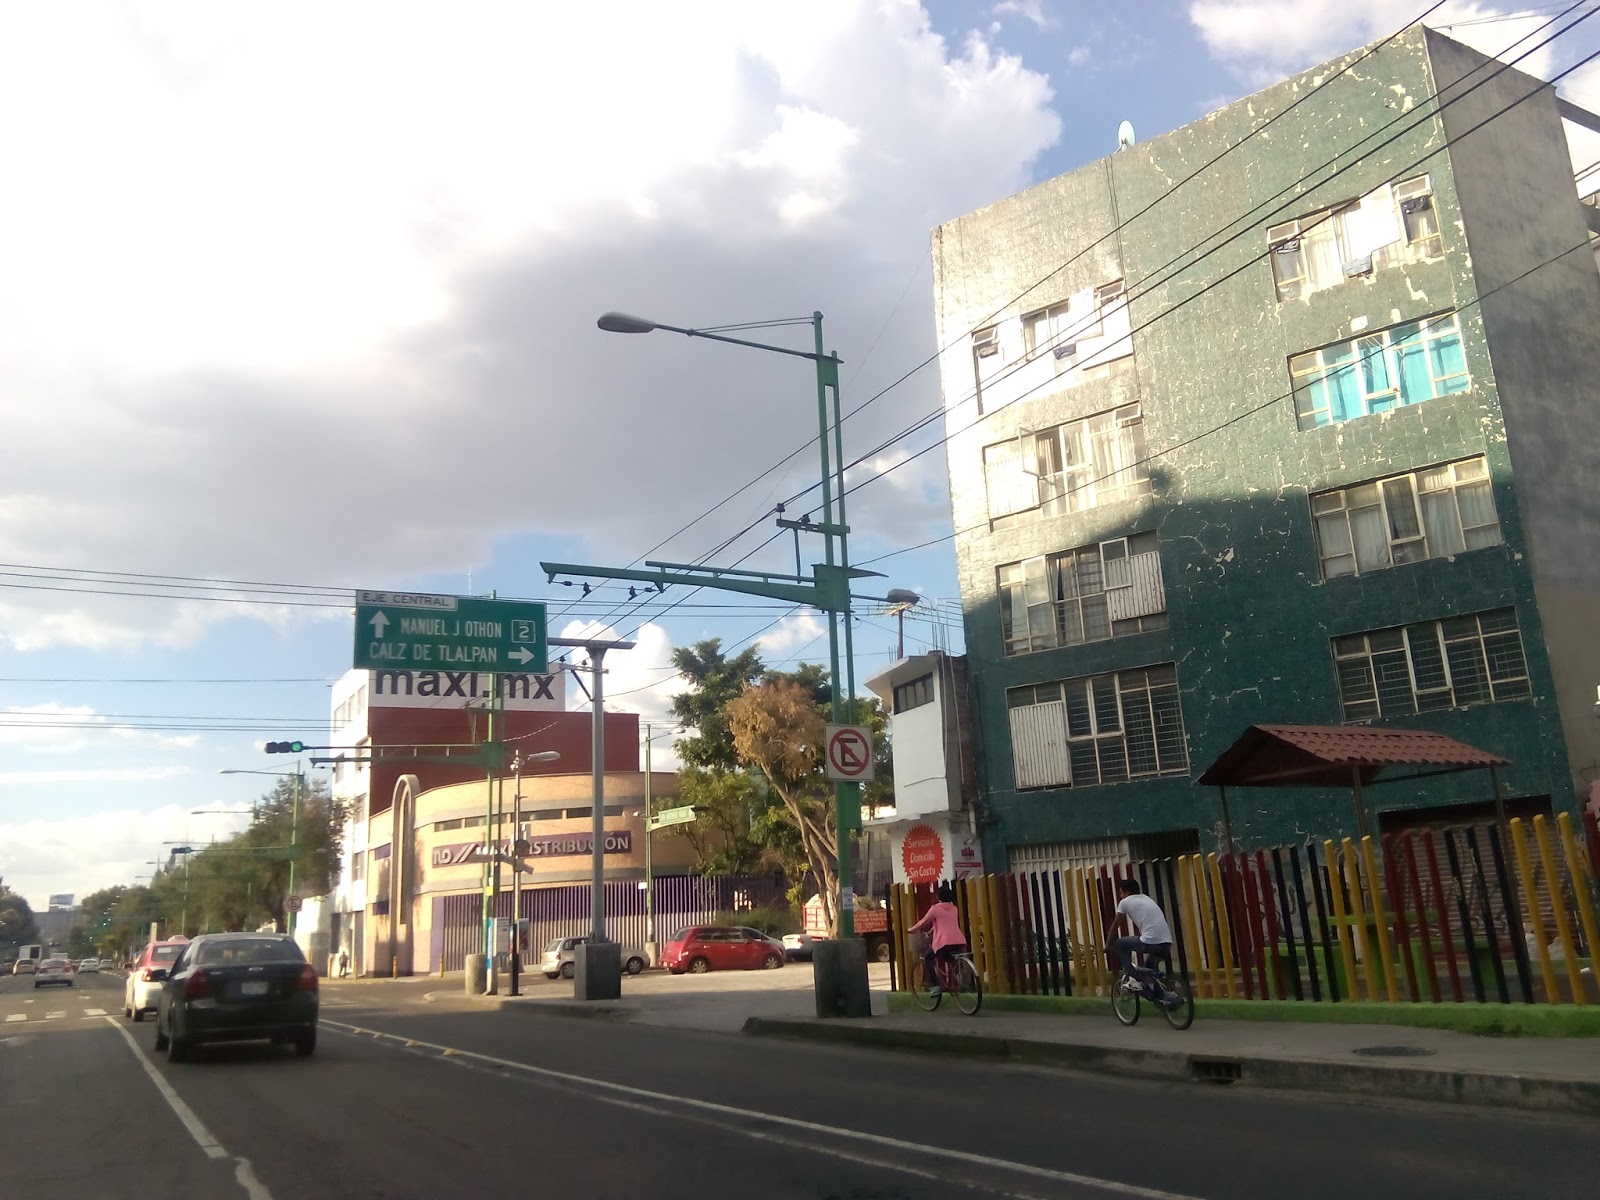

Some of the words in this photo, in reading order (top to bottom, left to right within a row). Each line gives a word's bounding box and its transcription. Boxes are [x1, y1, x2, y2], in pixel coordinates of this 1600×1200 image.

[363, 592, 386, 603] EJE
[393, 594, 449, 607] CENTRAL
[401, 618, 448, 637] MANUEL
[452, 621, 460, 638] J
[465, 620, 502, 638] OTHON
[519, 625, 530, 638] 2
[369, 642, 407, 660] CALZ
[413, 643, 433, 661] DE
[438, 644, 497, 664] TLALPAN
[909, 867, 919, 879] Sin
[919, 865, 936, 877] Costo
